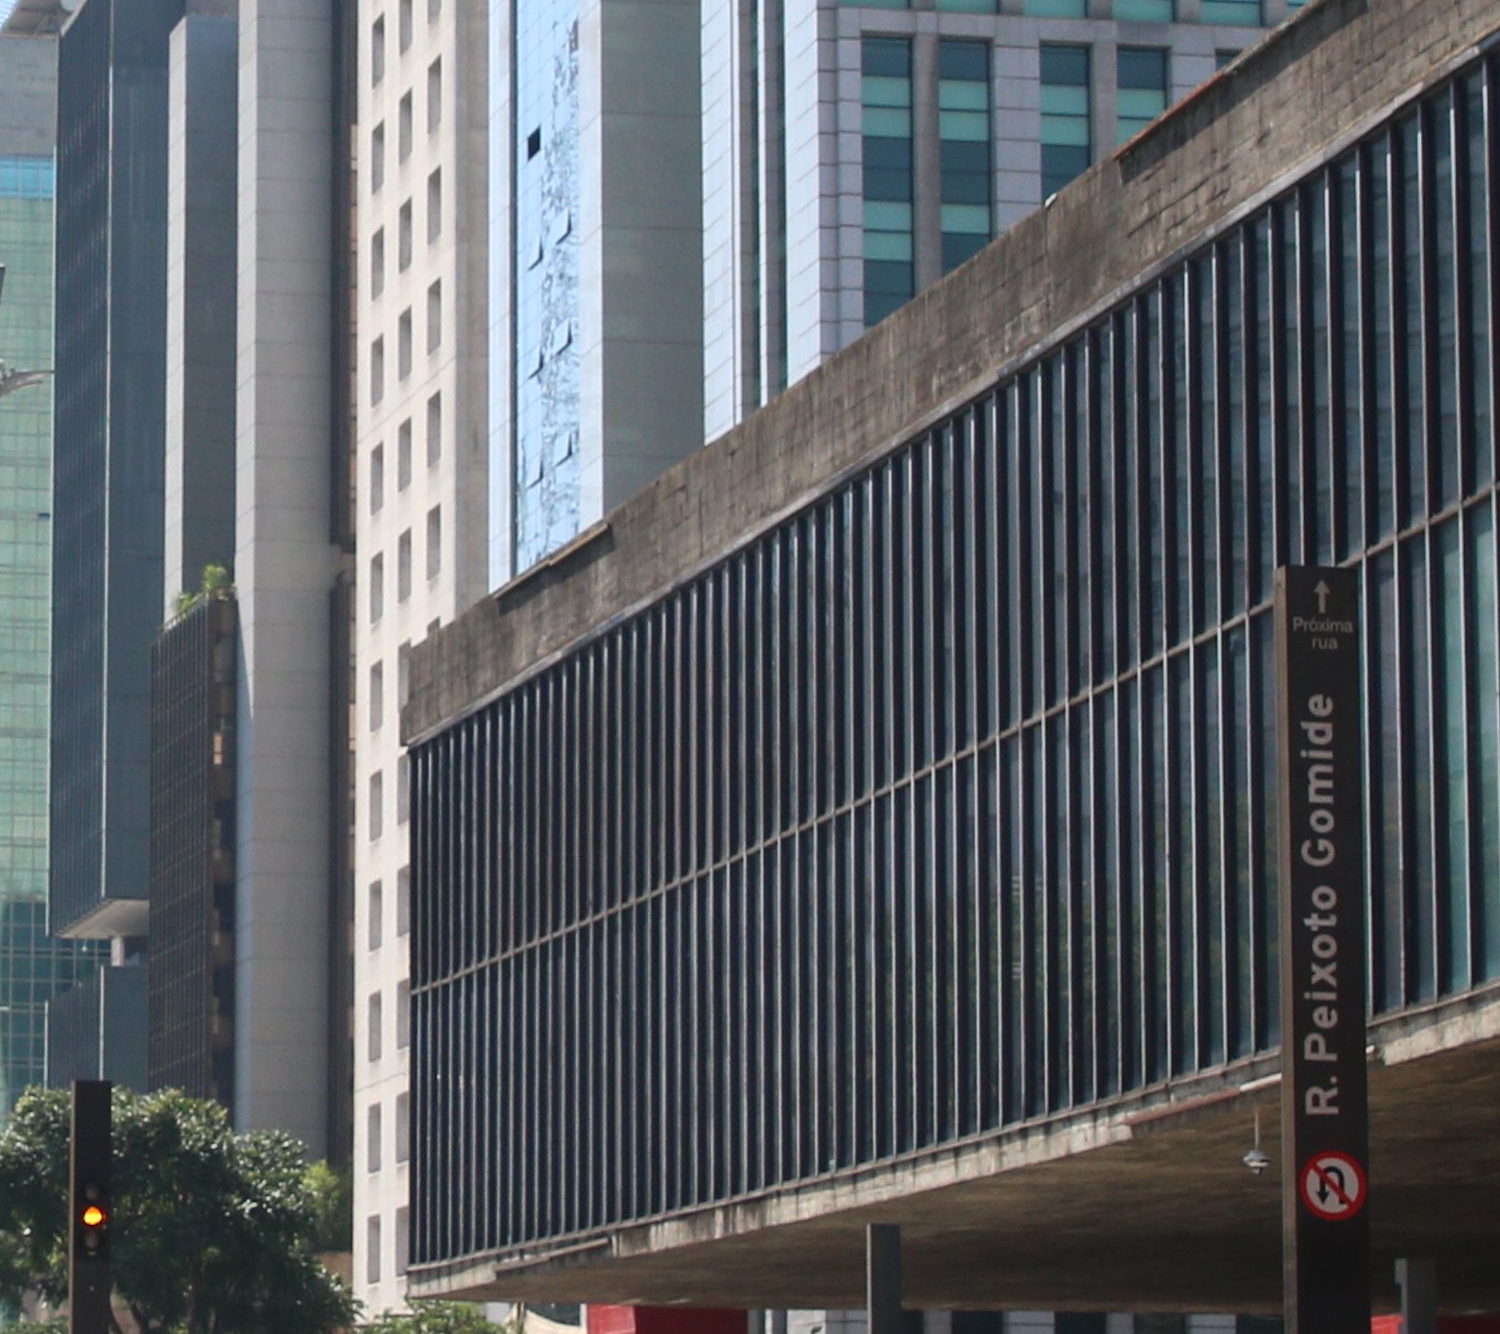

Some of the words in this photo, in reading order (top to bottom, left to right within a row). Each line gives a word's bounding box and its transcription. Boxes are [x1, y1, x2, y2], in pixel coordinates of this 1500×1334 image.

[1293, 615, 1354, 637] Próxima
[1311, 636, 1338, 650] rua
[1300, 692, 1335, 867] Gomide
[1302, 884, 1339, 1063] Peixoto
[1304, 1075, 1340, 1116] R.
